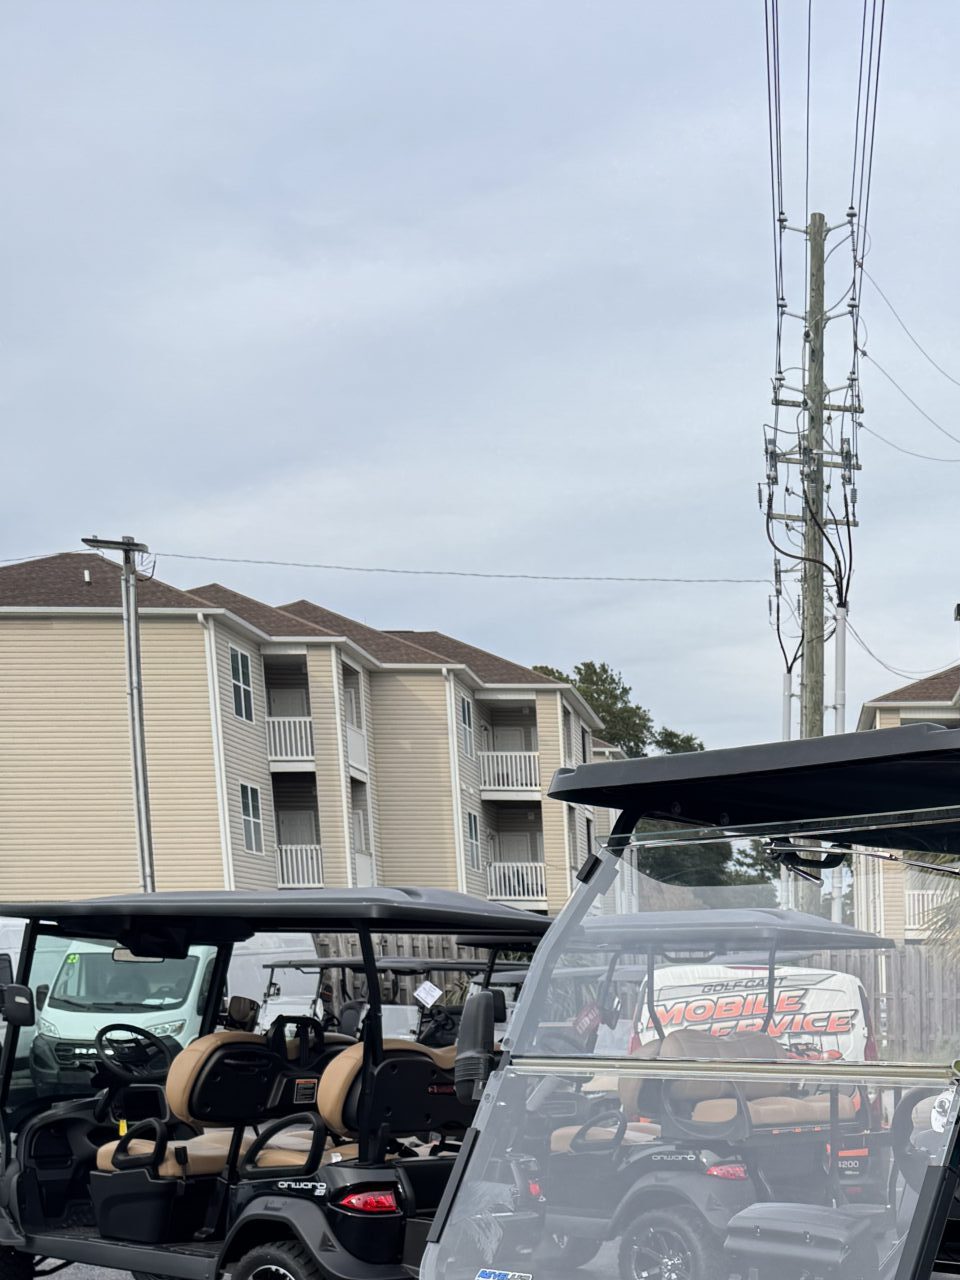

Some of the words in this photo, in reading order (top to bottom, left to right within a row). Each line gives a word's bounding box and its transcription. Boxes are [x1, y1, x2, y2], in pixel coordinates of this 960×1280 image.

[744, 976, 787, 991] CAT
[647, 989, 808, 1029] MOBILE
[686, 1009, 858, 1038] ERVICE
